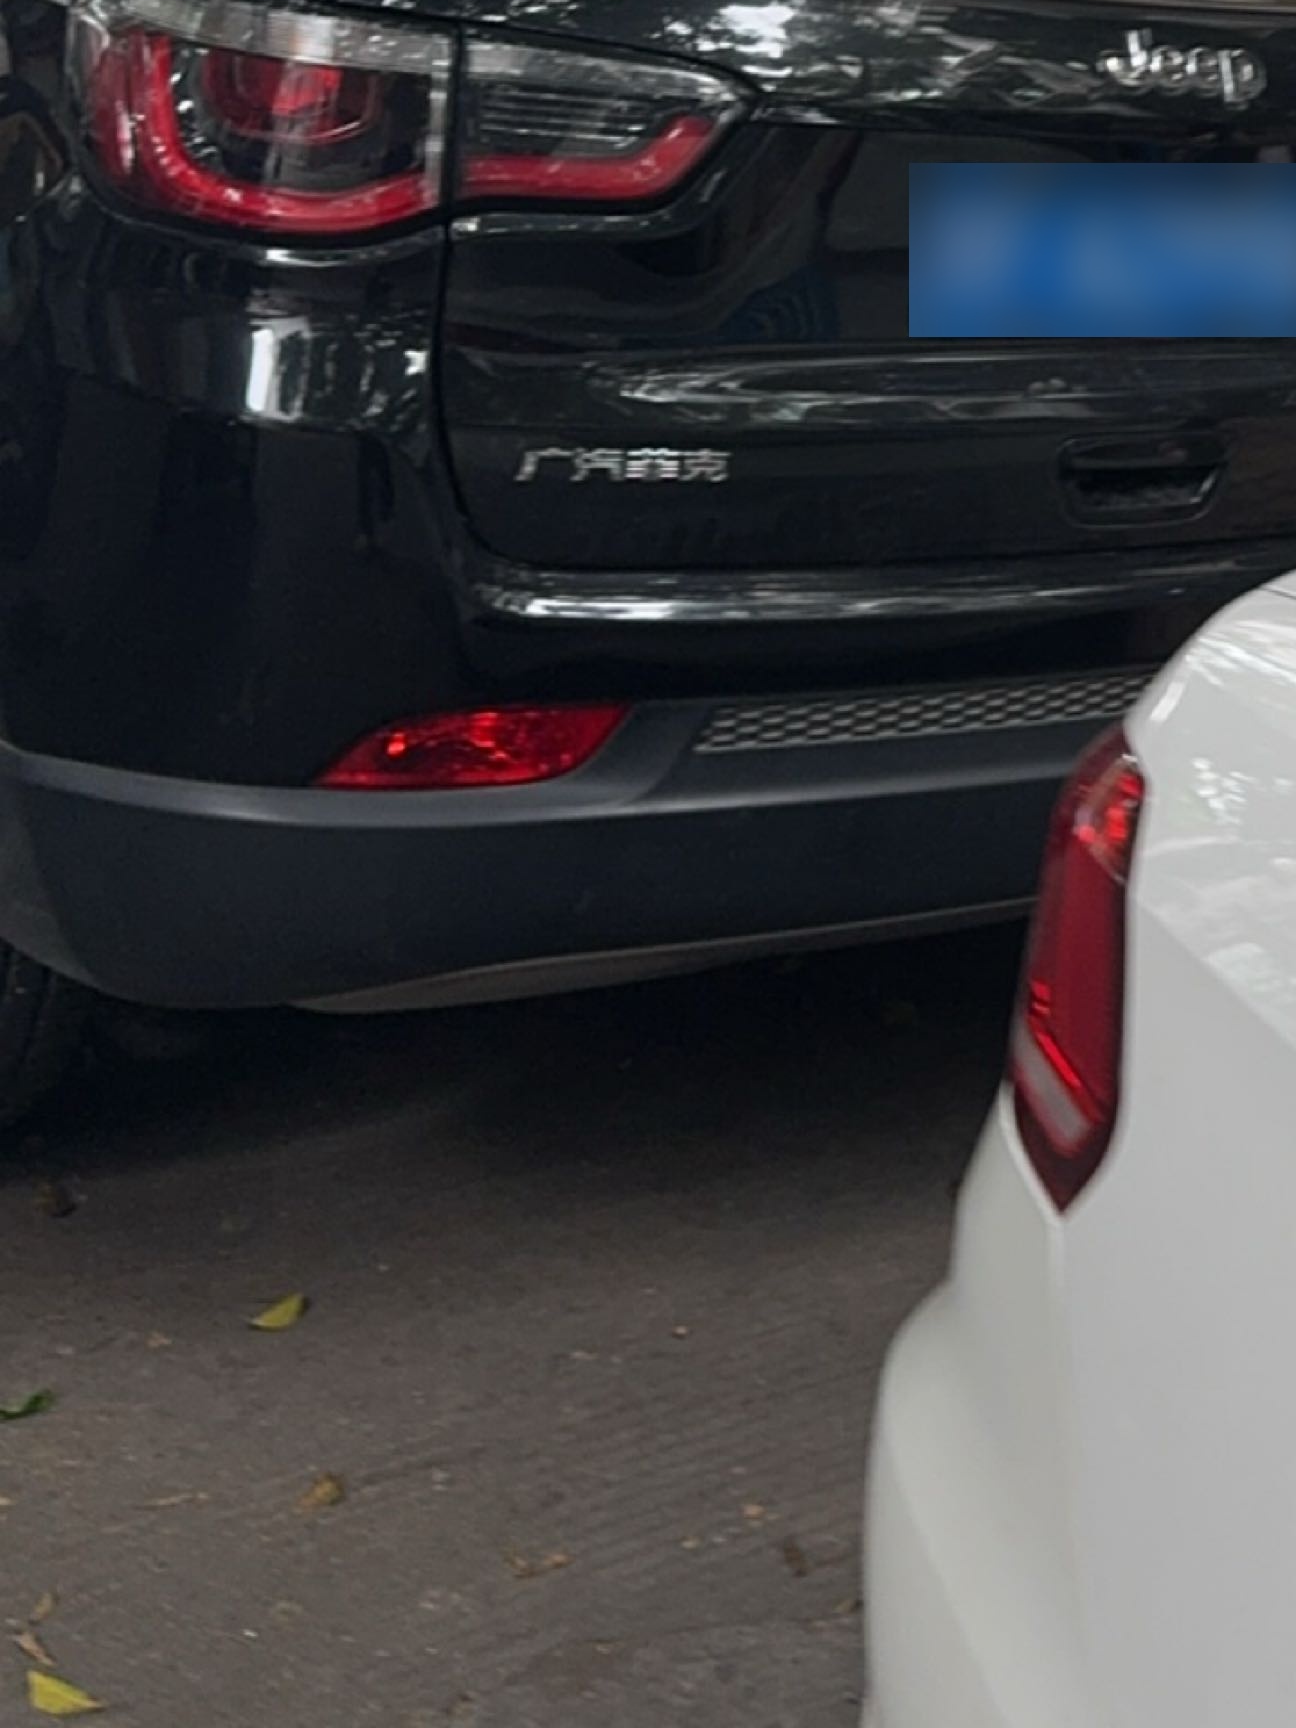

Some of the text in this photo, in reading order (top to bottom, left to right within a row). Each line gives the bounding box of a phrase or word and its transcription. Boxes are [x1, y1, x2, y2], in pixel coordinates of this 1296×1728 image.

[1096, 28, 1267, 110] Jeep
[514, 446, 732, 483] 广汽菲克
